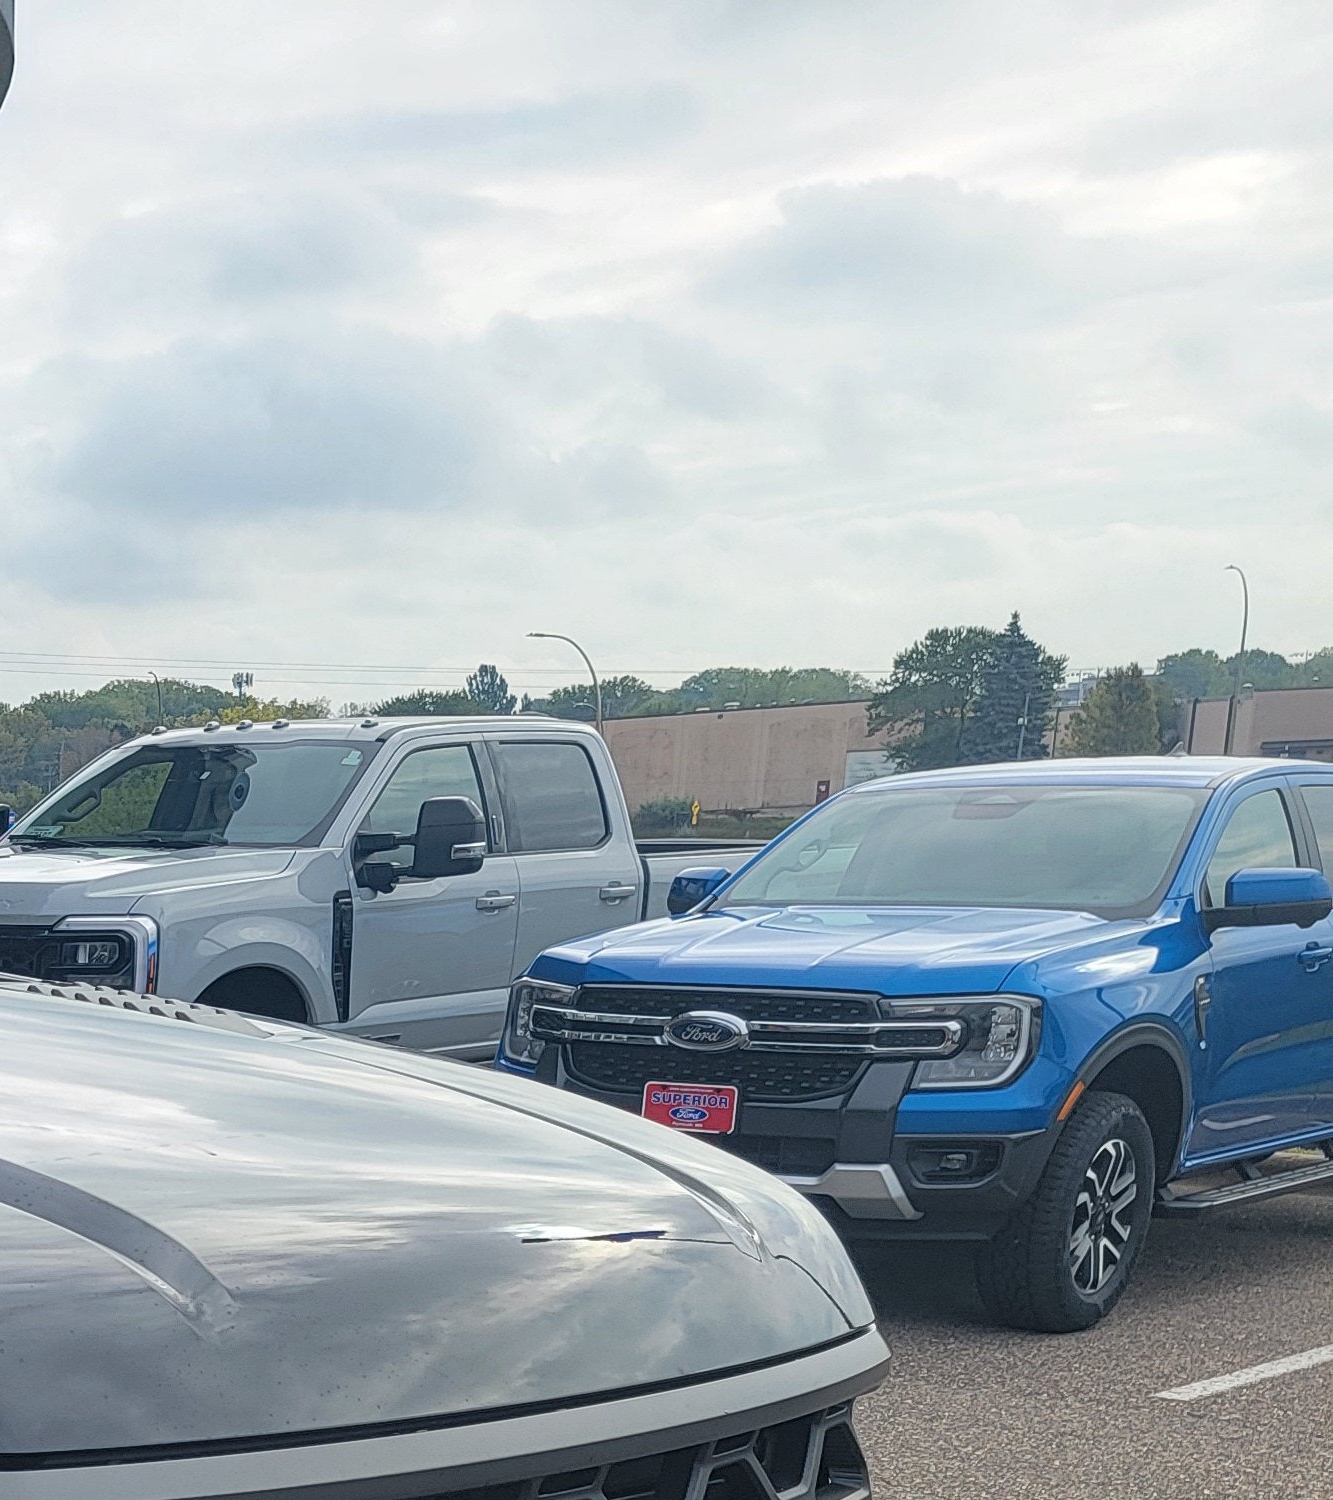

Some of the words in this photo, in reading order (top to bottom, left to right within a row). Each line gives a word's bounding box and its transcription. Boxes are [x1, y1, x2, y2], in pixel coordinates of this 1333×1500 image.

[682, 1023, 722, 1041] Ford
[651, 1091, 729, 1108] SUPERIOR
[676, 1109, 701, 1119] Ford
